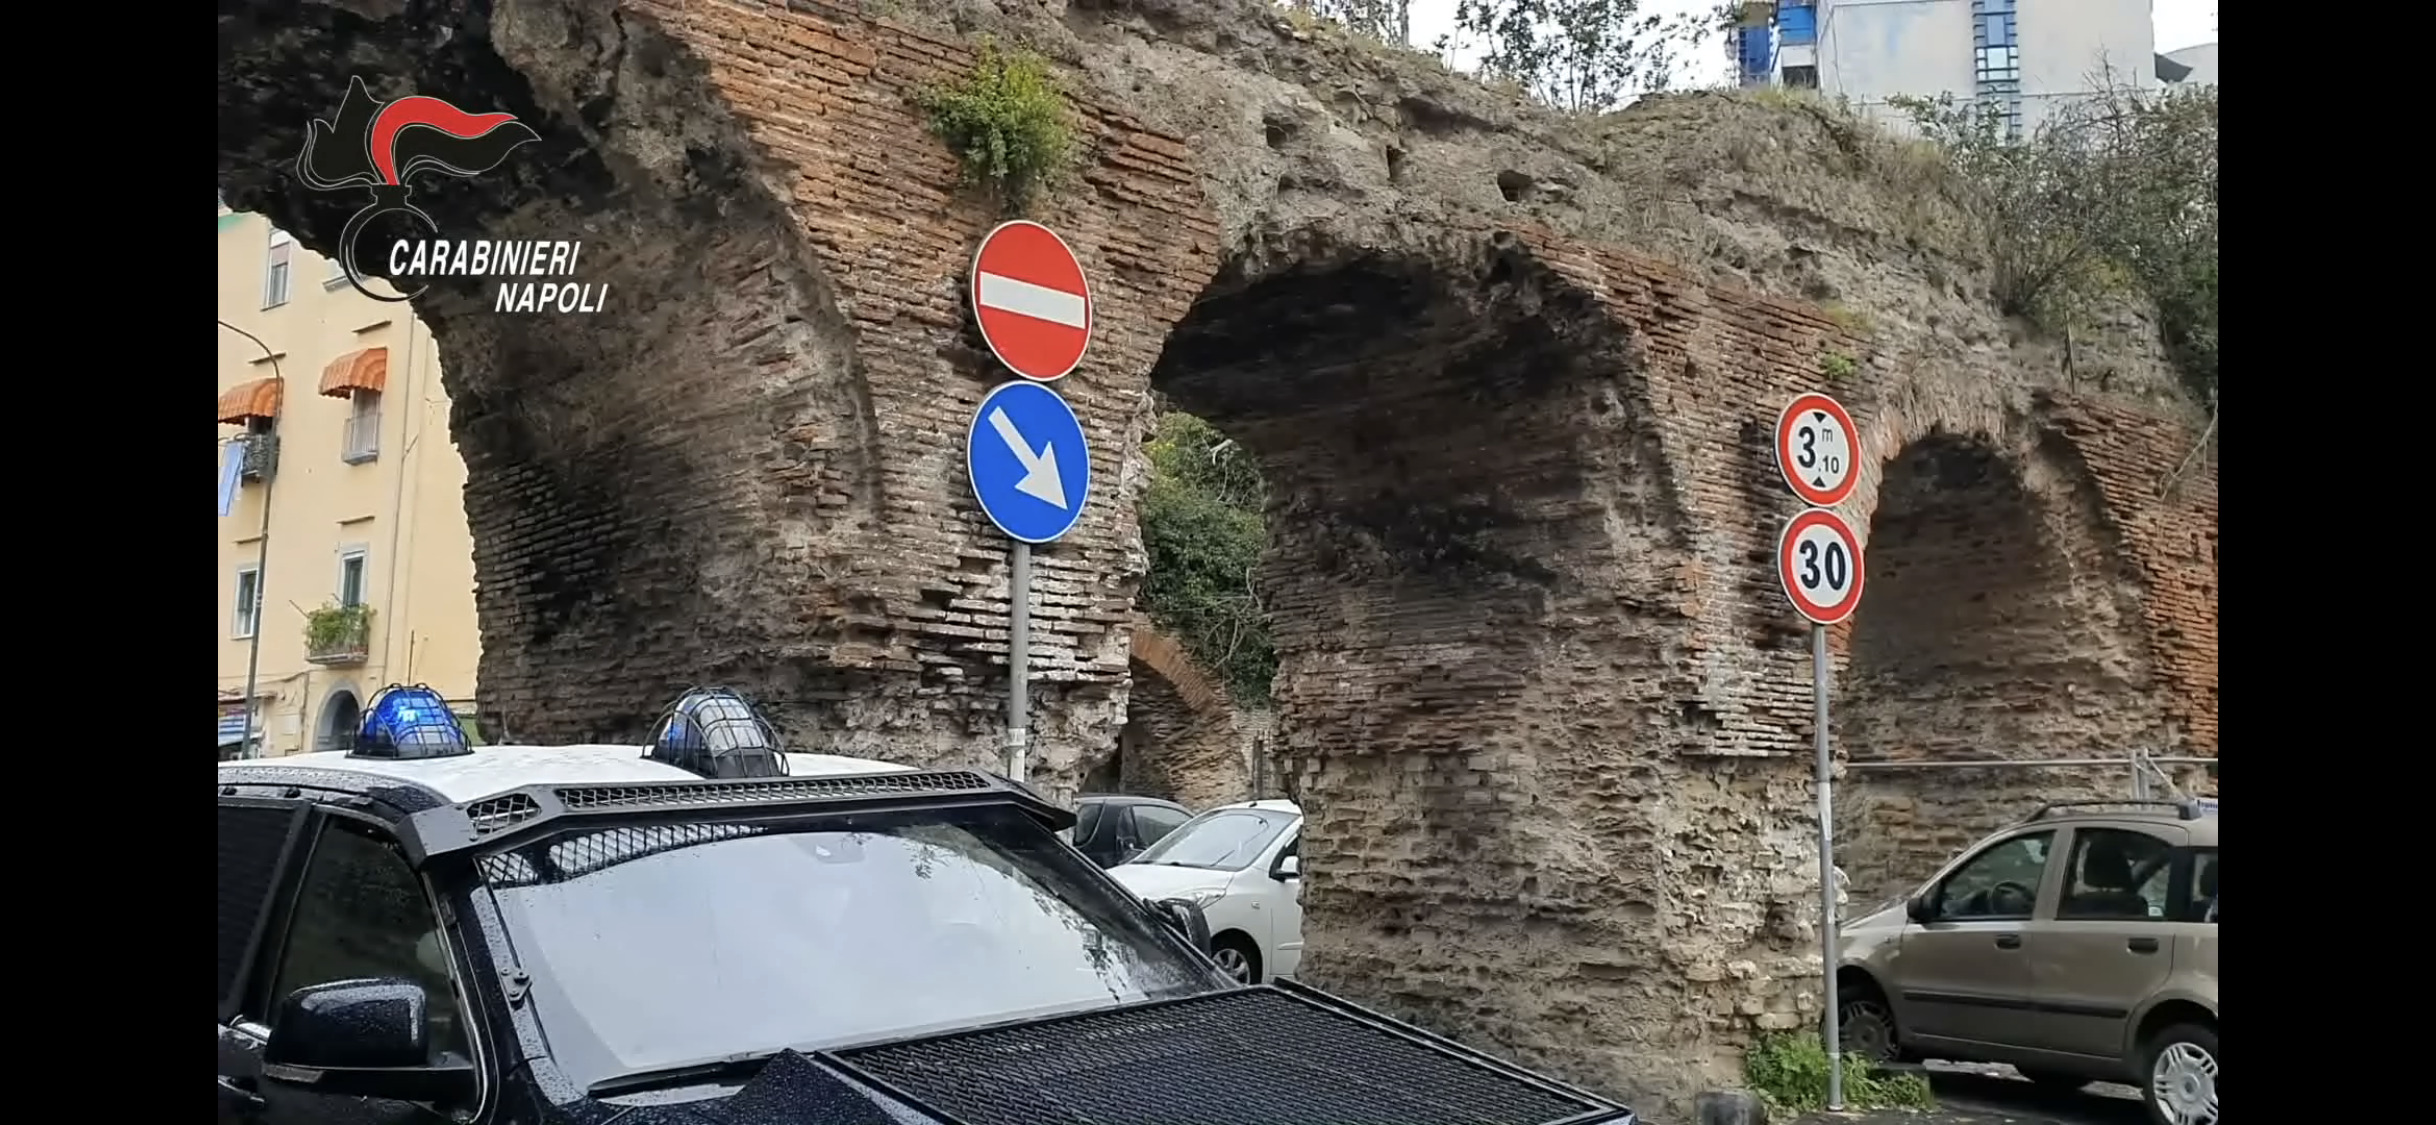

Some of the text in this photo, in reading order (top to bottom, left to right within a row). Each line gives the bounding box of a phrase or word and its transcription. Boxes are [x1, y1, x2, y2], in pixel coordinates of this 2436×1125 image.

[1797, 425, 1816, 469] 3
[1821, 427, 1834, 443] m
[1799, 539, 1846, 591] 30
